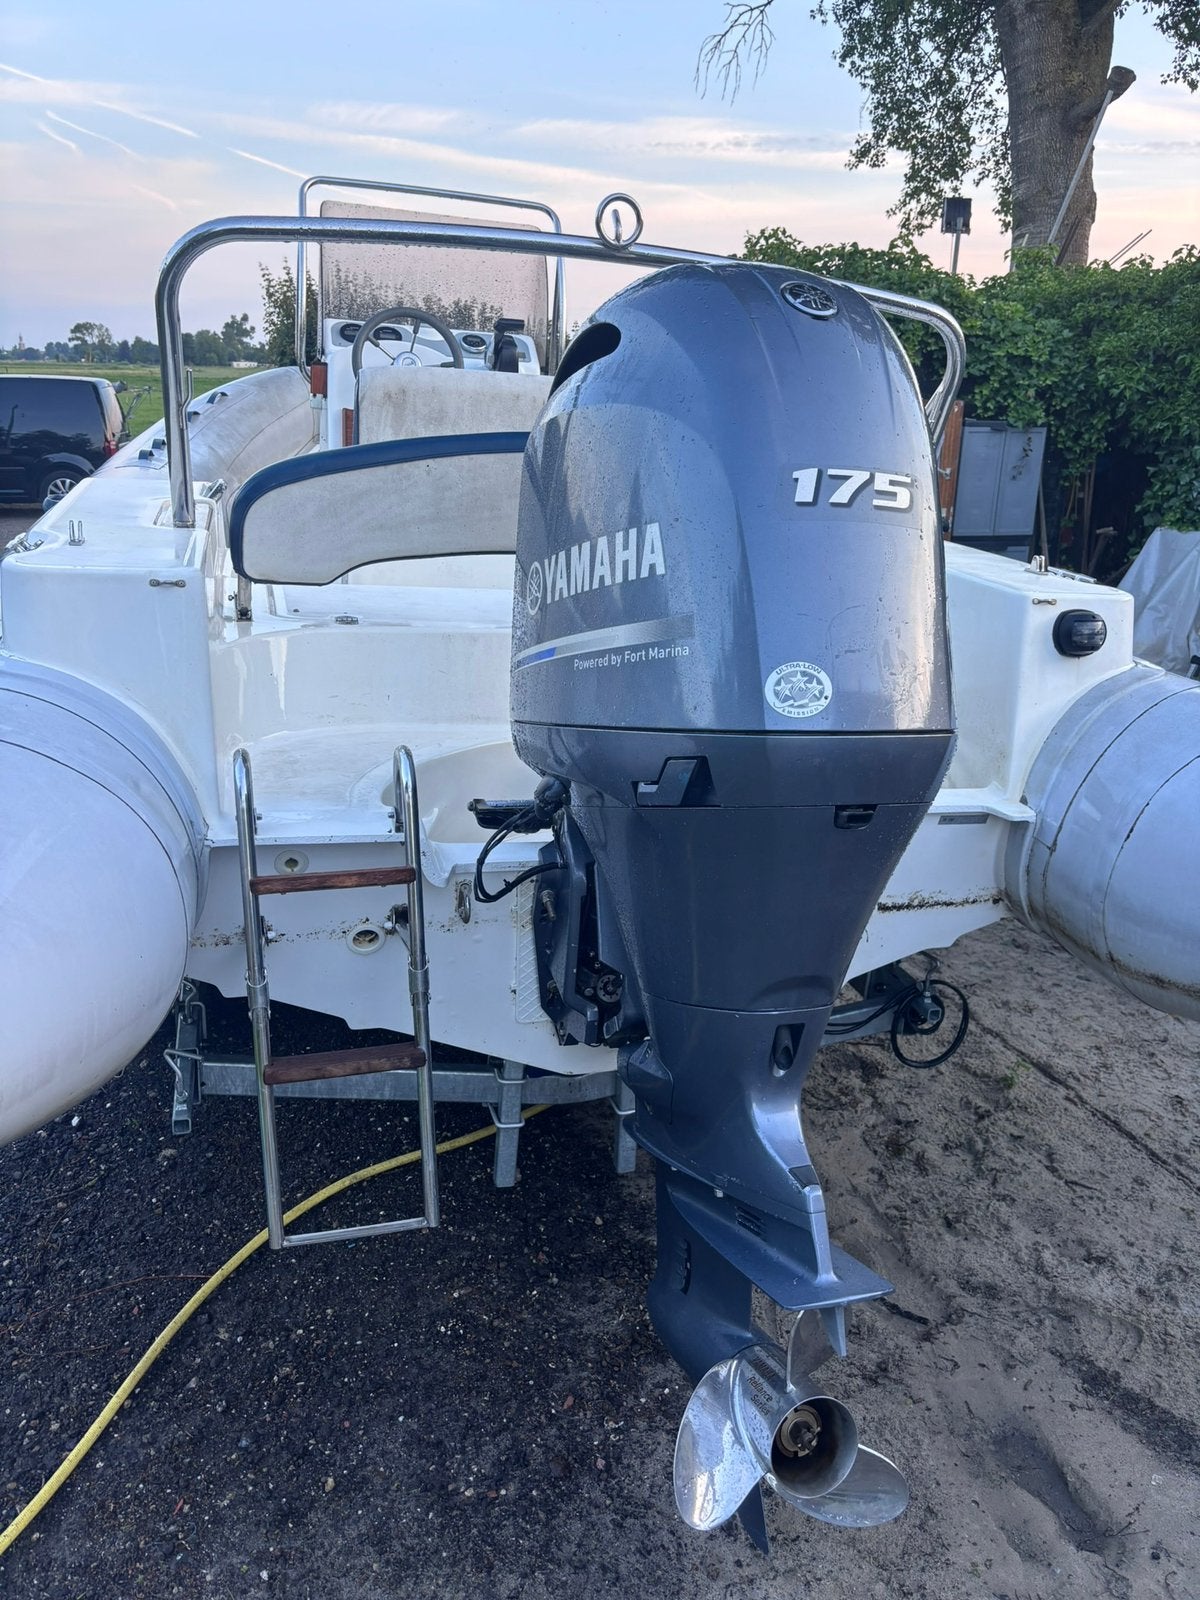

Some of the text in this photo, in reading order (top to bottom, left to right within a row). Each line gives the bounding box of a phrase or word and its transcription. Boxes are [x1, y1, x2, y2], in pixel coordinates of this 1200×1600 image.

[792, 468, 912, 509] 175
[544, 522, 666, 605] YAMAHA
[573, 644, 690, 671] Powered by Fort Marina
[781, 706, 820, 716] EMISSION
[747, 1376, 773, 1403] Reliance
[751, 1394, 770, 1416] Series
